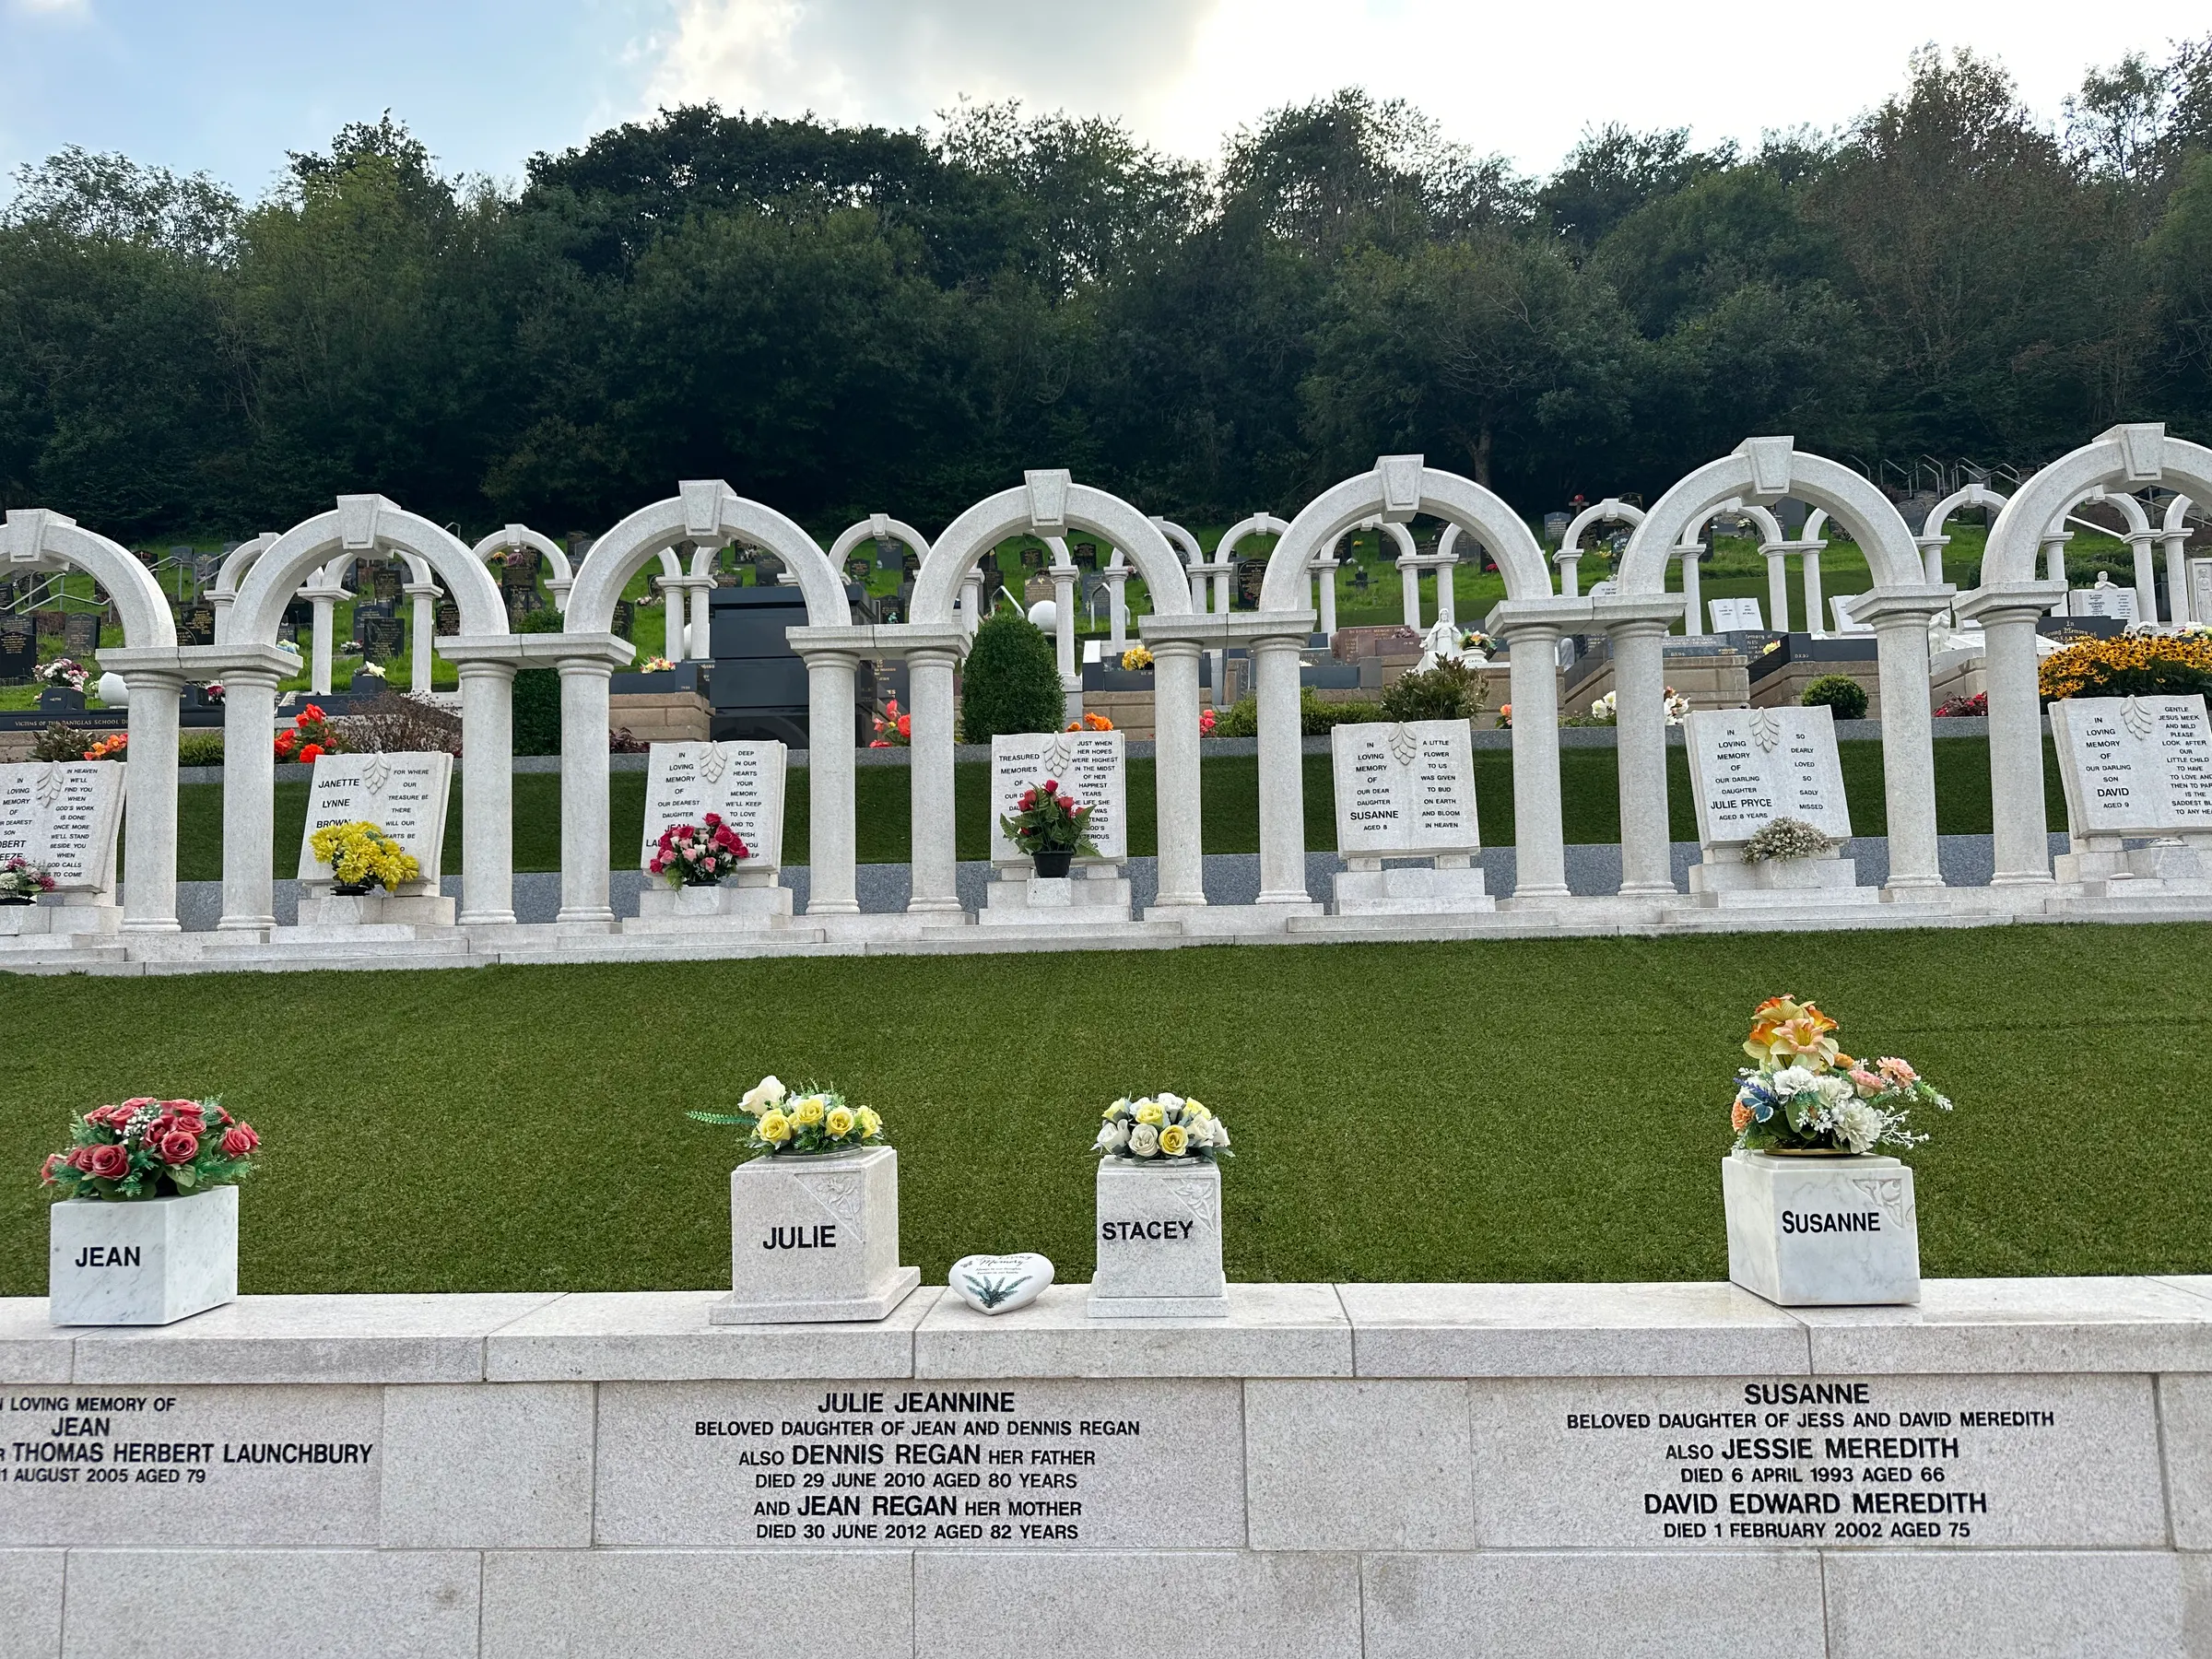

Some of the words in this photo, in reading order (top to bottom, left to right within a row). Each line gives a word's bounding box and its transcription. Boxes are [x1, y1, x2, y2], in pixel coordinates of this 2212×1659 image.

[999, 753, 1040, 762] TREASURED
[318, 778, 360, 788] JANETTE
[2097, 788, 2130, 797] DAVID
[322, 799, 351, 808] LYNNE
[1710, 800, 1738, 810] JULIE
[1741, 799, 1772, 807] PRYCE
[1350, 811, 1399, 821] SUSANNE
[1102, 1220, 1193, 1240] STACEY
[1783, 1211, 1880, 1233] SUSANNE
[763, 1225, 836, 1250] JULIE
[76, 1247, 140, 1267] JEAN
[1745, 1383, 1869, 1405] SUSANNE
[11, 1397, 68, 1411] LOVING
[76, 1397, 147, 1411] MEMORY
[154, 1397, 176, 1411] OF
[818, 1393, 883, 1413] JULIE
[894, 1393, 1015, 1413] JEANNINE
[52, 1418, 110, 1437] JEAN
[696, 1421, 773, 1435] BELOVED
[782, 1421, 873, 1436] DAUGHTER
[881, 1421, 904, 1436] OF
[912, 1421, 956, 1435] JEAN
[963, 1421, 999, 1435] AND
[1007, 1421, 1071, 1435] DENNIS
[1080, 1421, 1139, 1435] REGAN
[1568, 1414, 1650, 1429] BELOVED
[1659, 1414, 1756, 1428] DAUGHTER
[1765, 1413, 1789, 1428] OF
[1797, 1413, 1844, 1428] JESS
[1853, 1413, 1890, 1427] AND
[1900, 1412, 1951, 1427] DAVID
[1960, 1411, 2053, 1427] MEREDITH
[13, 1442, 103, 1463] THOMAS
[114, 1443, 214, 1463] HERBERT
[224, 1443, 372, 1464] LAUNCHBURY
[739, 1451, 784, 1465] ALSO
[793, 1444, 883, 1465] DENNIS
[896, 1444, 980, 1465] REGAN
[989, 1450, 1023, 1465] HER
[1031, 1450, 1095, 1465] FATHER
[1665, 1444, 1713, 1459] ALSO
[1722, 1438, 1813, 1460] JESSIE
[1825, 1438, 1959, 1458] MEREDITH
[14, 1468, 80, 1482] AUGUST
[87, 1468, 128, 1482] 2005
[135, 1469, 180, 1482] AGED
[187, 1469, 206, 1483] 79
[756, 1474, 795, 1488] DIED
[804, 1473, 824, 1488] 29
[832, 1473, 876, 1488] JUNE
[884, 1473, 924, 1488] 2010
[933, 1473, 980, 1488] AGED
[989, 1473, 1011, 1488] 80
[1019, 1474, 1077, 1488] YEARS
[1681, 1468, 1723, 1483] DIED
[1732, 1468, 1743, 1482] 6
[1752, 1467, 1803, 1482] APRIL
[1810, 1467, 1853, 1482] 1993
[1863, 1467, 1912, 1482] AGED
[1921, 1467, 1945, 1482] 66
[754, 1501, 790, 1515] AND
[797, 1496, 860, 1516] JEAN
[873, 1496, 957, 1516] REGAN
[966, 1501, 1000, 1515] HER
[1008, 1500, 1081, 1516] MOTHER
[1644, 1494, 1717, 1513] DAVID
[1730, 1493, 1840, 1514] EDWARD
[1853, 1493, 1986, 1513] MEREDITH
[757, 1524, 795, 1538] DIED
[804, 1524, 825, 1538] 30
[832, 1524, 877, 1538] JUNE
[886, 1524, 926, 1538] 2012
[935, 1524, 982, 1538] AGED
[991, 1524, 1011, 1539] 82
[1019, 1524, 1077, 1539] YEARS
[1665, 1524, 1706, 1537] DIED
[1714, 1524, 1721, 1537] 1
[1730, 1523, 1826, 1538] FEBRUARY
[1835, 1523, 1882, 1537] 2002
[1890, 1523, 1940, 1537] AGED
[1948, 1523, 1970, 1537] 75
